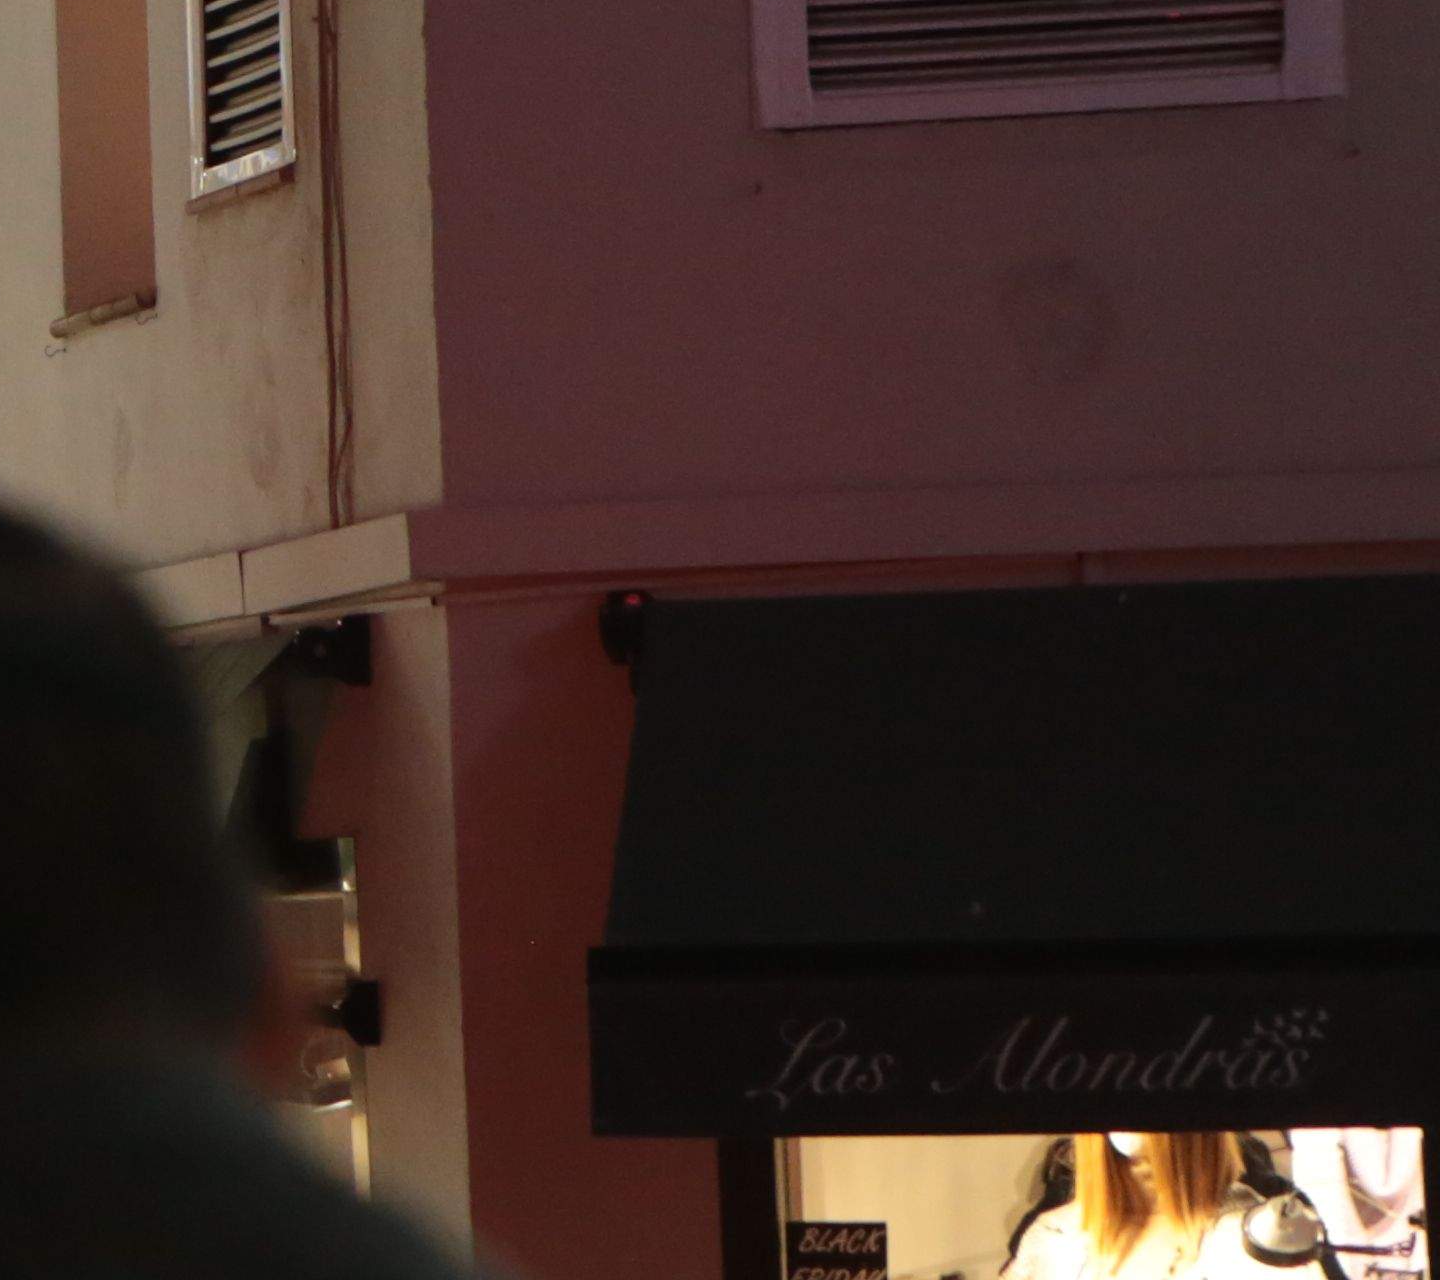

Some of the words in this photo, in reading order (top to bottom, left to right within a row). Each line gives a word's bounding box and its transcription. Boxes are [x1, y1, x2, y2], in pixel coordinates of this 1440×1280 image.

[745, 1017, 895, 1110] Las
[928, 1014, 1310, 1096] Alondras
[799, 1226, 887, 1254] BLACK
